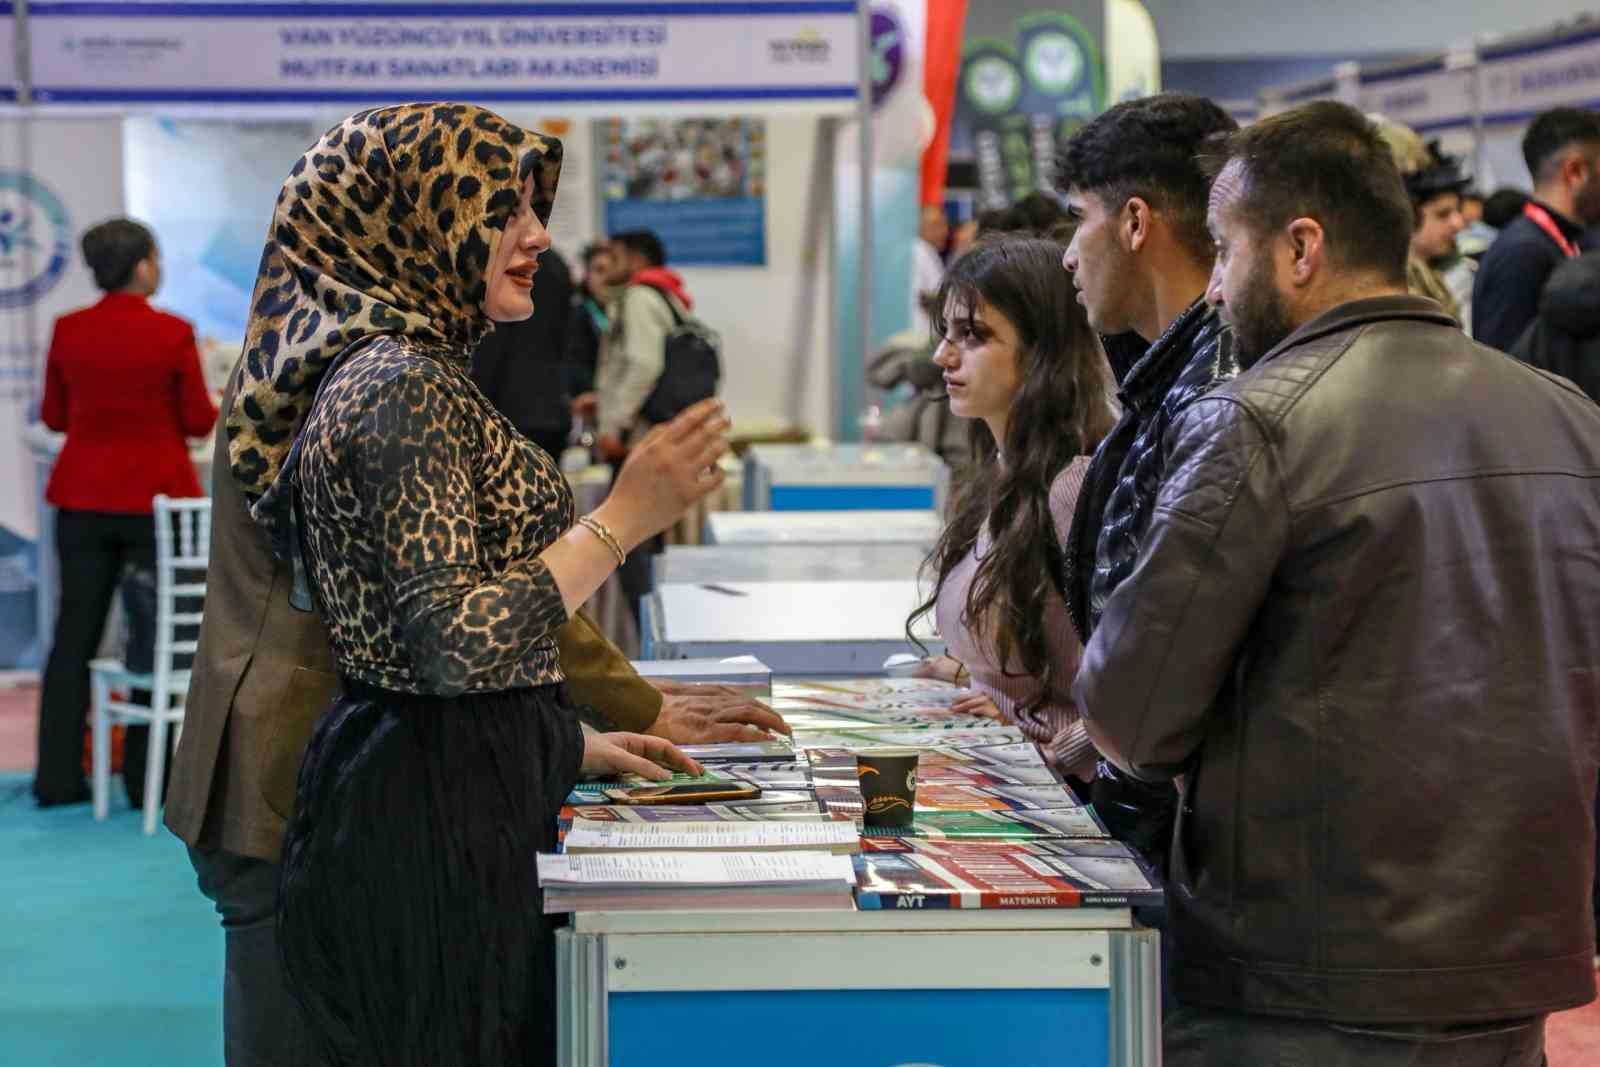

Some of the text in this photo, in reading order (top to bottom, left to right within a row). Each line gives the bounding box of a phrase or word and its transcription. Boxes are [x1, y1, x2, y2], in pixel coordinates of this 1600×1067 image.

[280, 26, 333, 46] VAN
[338, 21, 456, 47] YÜZÜNCÜ
[461, 26, 493, 47] YIL
[896, 895, 926, 908] AYT
[999, 895, 1058, 906] MATEMATİK
